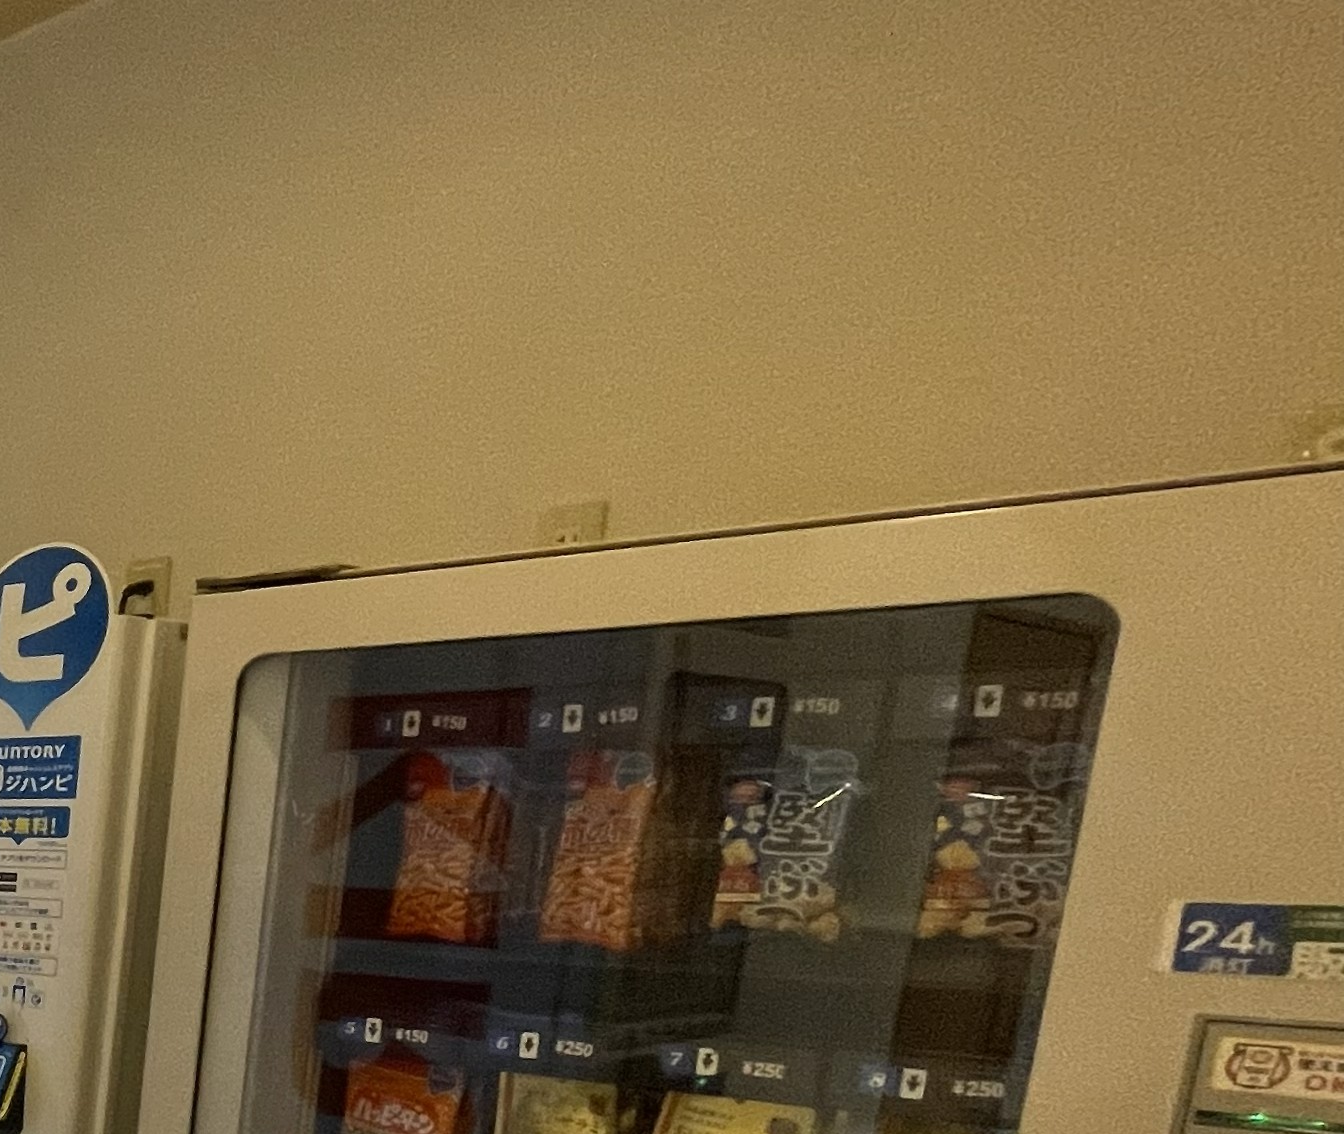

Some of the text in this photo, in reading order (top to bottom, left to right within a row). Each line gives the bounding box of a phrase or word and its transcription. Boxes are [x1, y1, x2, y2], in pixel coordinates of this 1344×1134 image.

[538, 712, 554, 728] 2
[719, 704, 738, 721] 3
[4, 773, 73, 793] ジハンピ
[1180, 919, 1278, 955] 24h
[344, 1021, 356, 1034] 5
[496, 1036, 510, 1050] 6
[669, 1052, 684, 1067] 7
